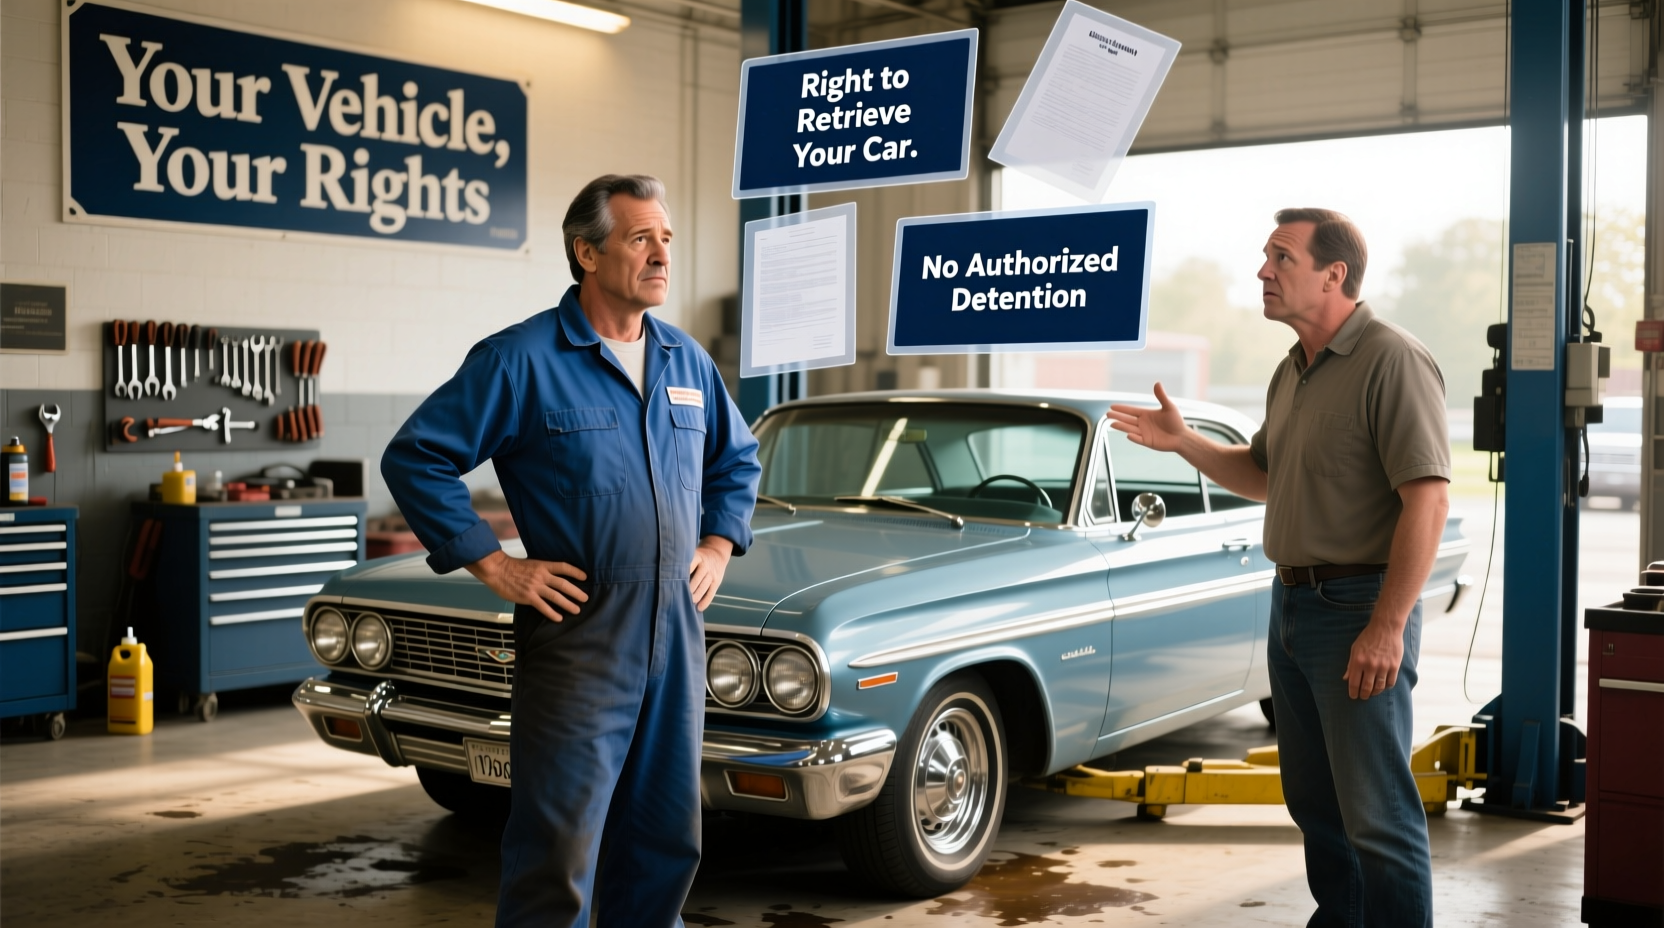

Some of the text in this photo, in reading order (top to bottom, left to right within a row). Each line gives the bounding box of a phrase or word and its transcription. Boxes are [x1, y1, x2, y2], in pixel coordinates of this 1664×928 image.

[99, 34, 511, 169] Your Vehicle,
[116, 121, 491, 234] Your Rights
